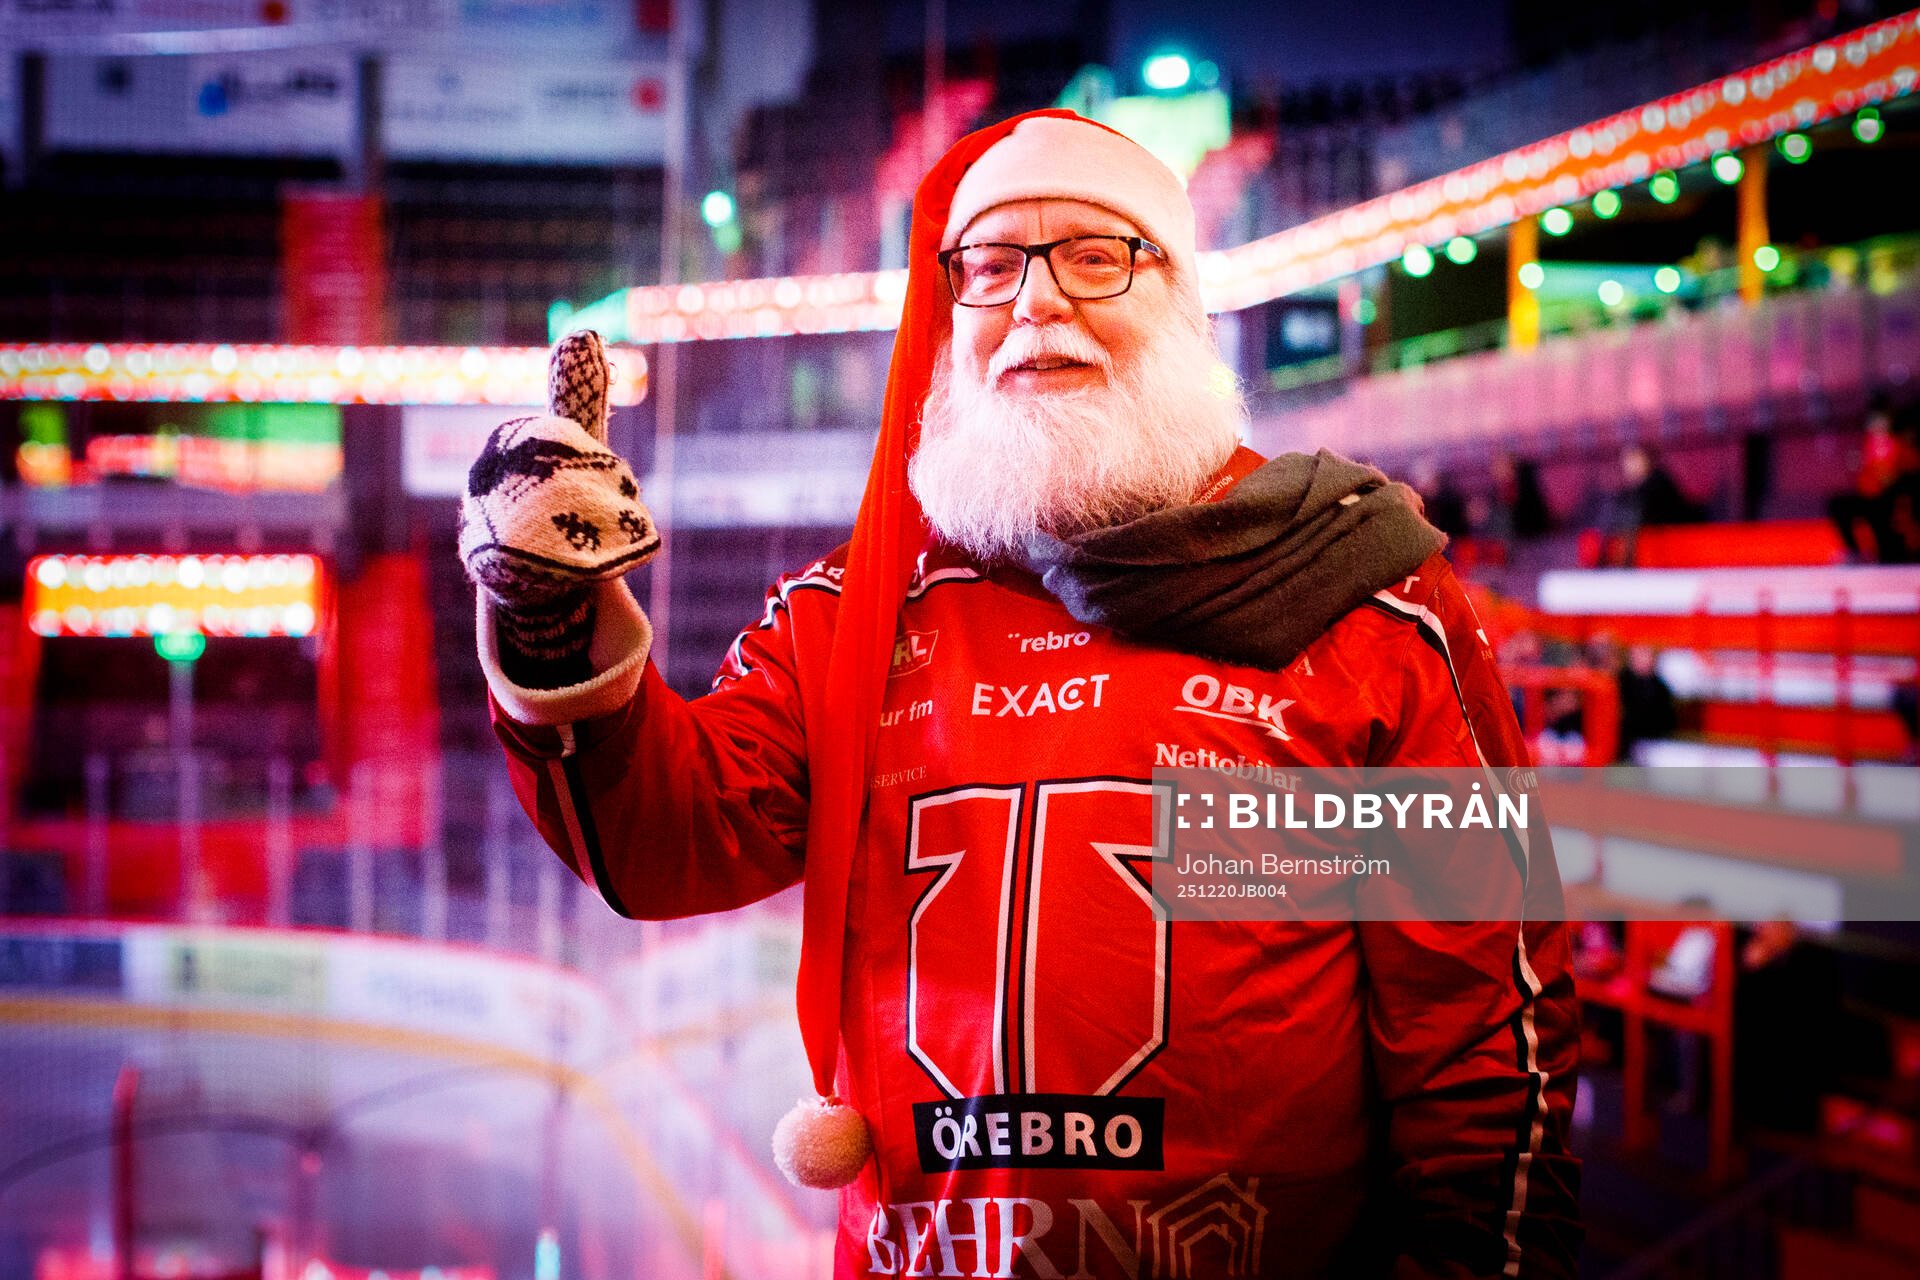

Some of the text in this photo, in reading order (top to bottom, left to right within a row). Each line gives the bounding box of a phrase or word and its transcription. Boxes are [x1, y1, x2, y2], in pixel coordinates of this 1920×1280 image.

[909, 699, 934, 721] fm
[971, 673, 1110, 717] EXACT
[1181, 674, 1296, 734] OBK
[871, 765, 927, 789] SERVICE
[1153, 742, 1303, 793] Nettobilar
[931, 1107, 1144, 1160] ÖREBRO
[867, 1197, 1151, 1280] BEHRN
